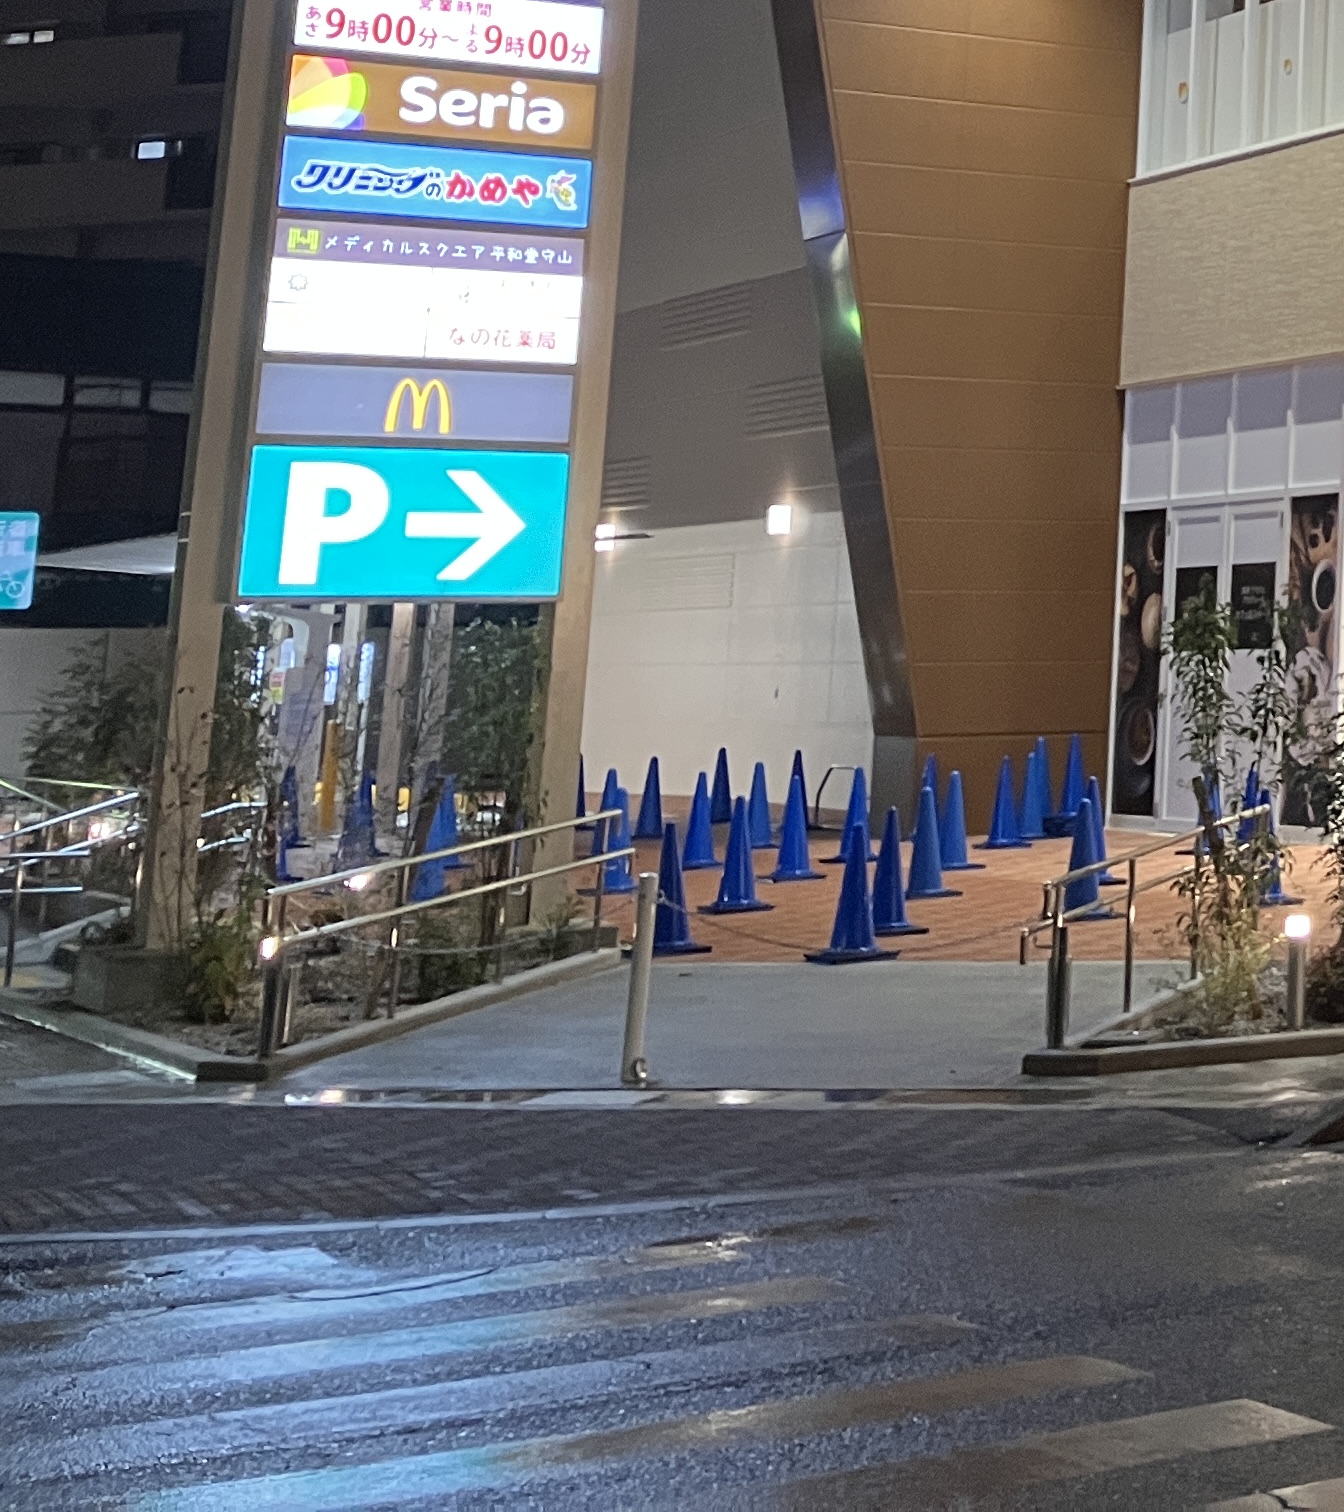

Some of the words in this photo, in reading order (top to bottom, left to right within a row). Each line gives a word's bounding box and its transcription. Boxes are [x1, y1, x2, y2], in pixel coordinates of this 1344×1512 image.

[398, 74, 566, 135] Seria
[448, 327, 557, 350] なの花薬局
[277, 460, 391, 586] P
